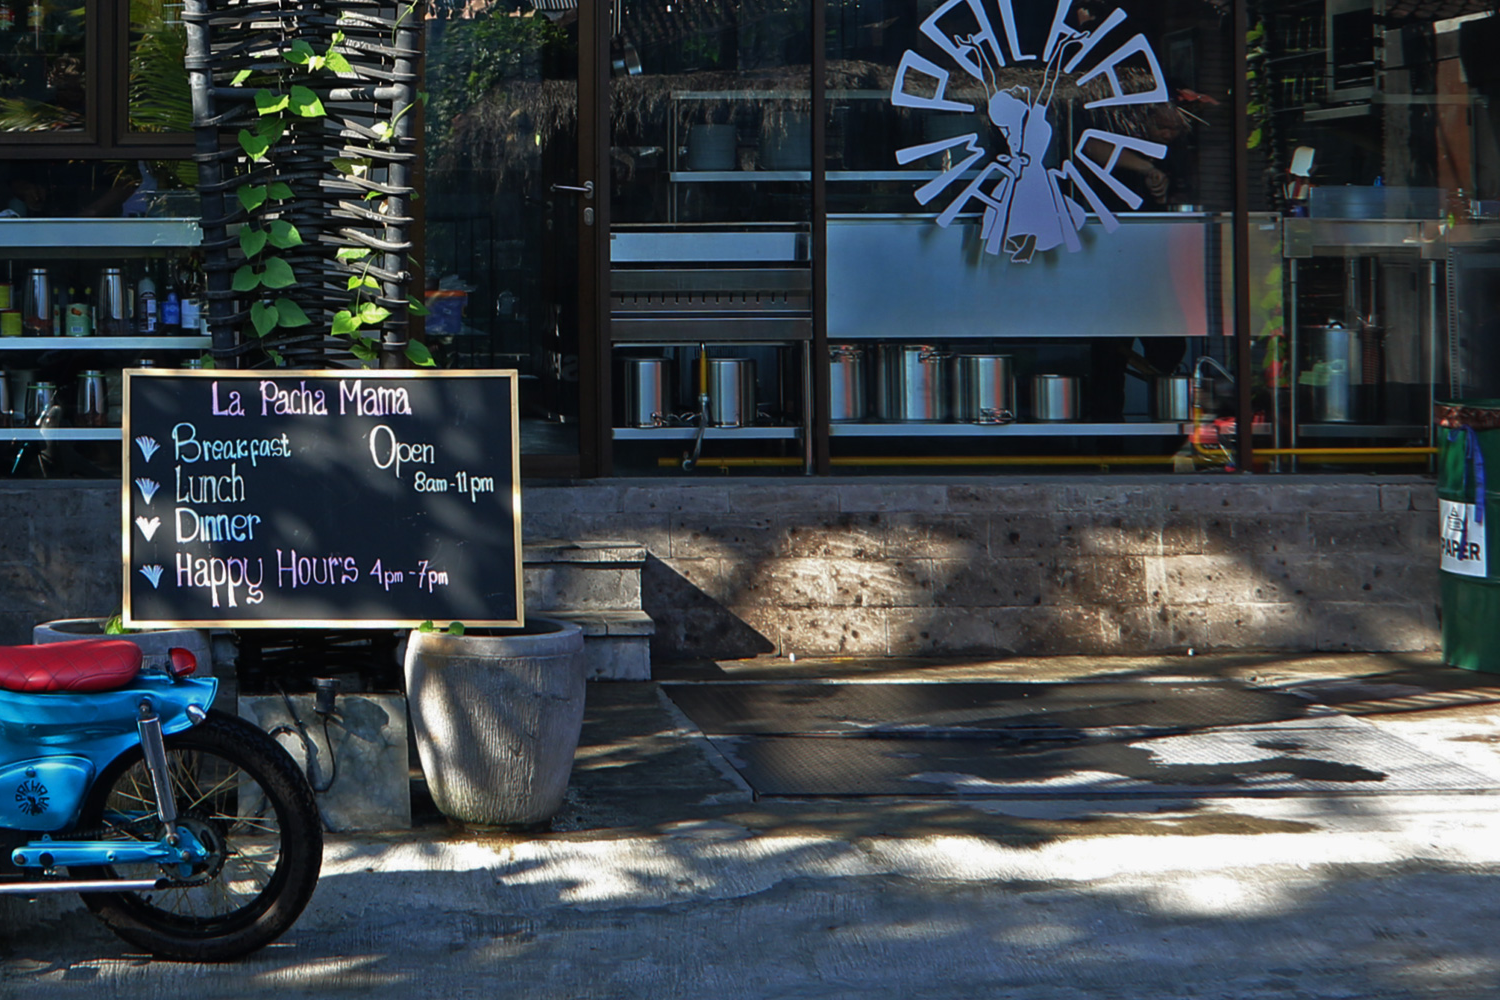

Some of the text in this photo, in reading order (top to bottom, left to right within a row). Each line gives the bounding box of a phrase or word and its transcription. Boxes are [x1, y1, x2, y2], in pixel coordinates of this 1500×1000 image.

[895, 128, 1168, 256] MAMA
[211, 379, 412, 417] La Pacha Mama
[171, 422, 292, 467] Breakfast
[369, 424, 435, 477] Open
[174, 463, 245, 504] Lunch
[175, 507, 262, 543] Dinner
[175, 552, 264, 608] Happy
